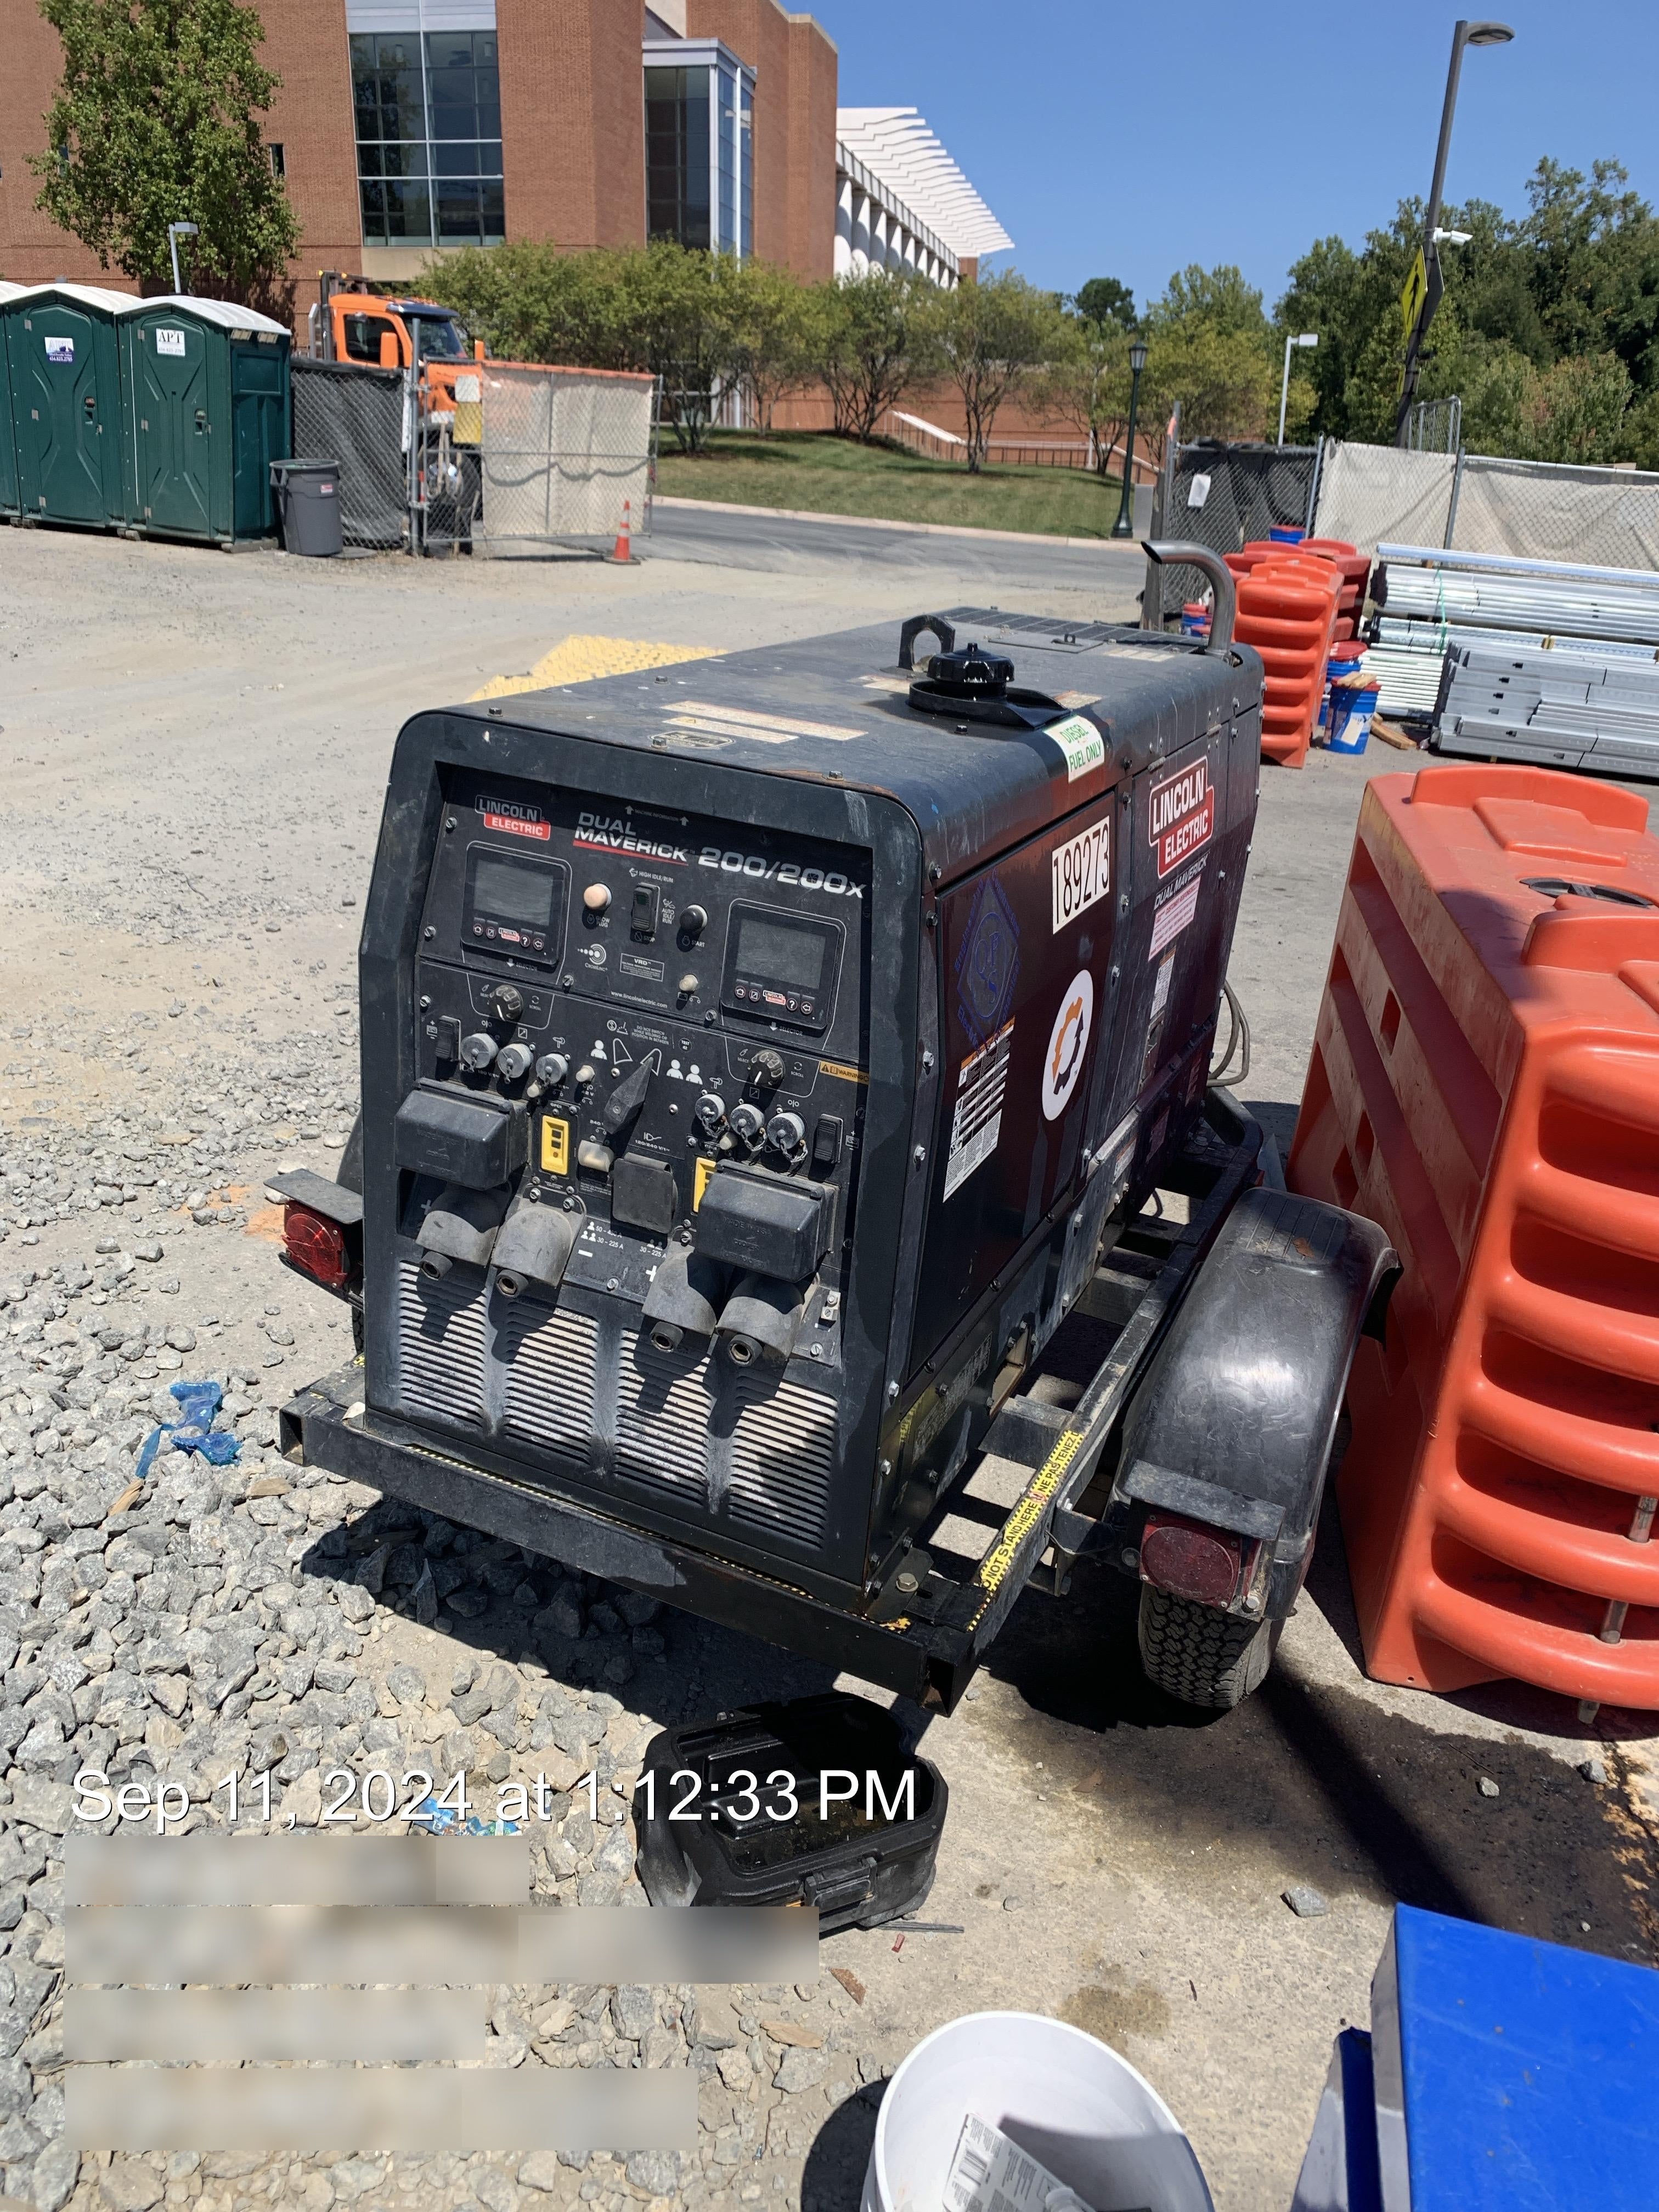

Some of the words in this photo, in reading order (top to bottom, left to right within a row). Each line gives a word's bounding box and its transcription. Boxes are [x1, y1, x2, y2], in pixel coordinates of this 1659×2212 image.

[159, 331, 183, 343] APT
[1059, 724, 1088, 742] DIESEL
[1069, 750, 1086, 772] FUEL
[1086, 741, 1101, 762] ONLY
[479, 798, 538, 822] LINCOLN
[1153, 767, 1204, 835] LINCOLN
[491, 816, 543, 836] ELECTRIC
[579, 812, 636, 836] DUAL
[574, 827, 689, 862] MAVERICK
[1165, 809, 1209, 865] ELECTRIC
[652, 873, 674, 883] IDLE/RUN
[1053, 823, 1109, 924] 189273
[1154, 883, 1173, 911] DUAL
[1174, 854, 1209, 894] MAVERICK
[644, 935, 656, 943] STOP
[691, 939, 706, 947] START
[611, 990, 668, 1009] www.lincolnelectric.com
[779, 1025, 803, 1036] SELECTOR
[838, 1069, 865, 1081] WARNING
[635, 1139, 658, 1149] 120/240
[651, 1249, 662, 1257] 225
[1037, 1480, 1051, 1492] NE
[1045, 1462, 1061, 1480] PAS
[1055, 1436, 1077, 1462] TENEZ
[986, 1557, 1004, 1580] NOT
[998, 1525, 1022, 1558] STAND
[1019, 1502, 1038, 1526] HERE
